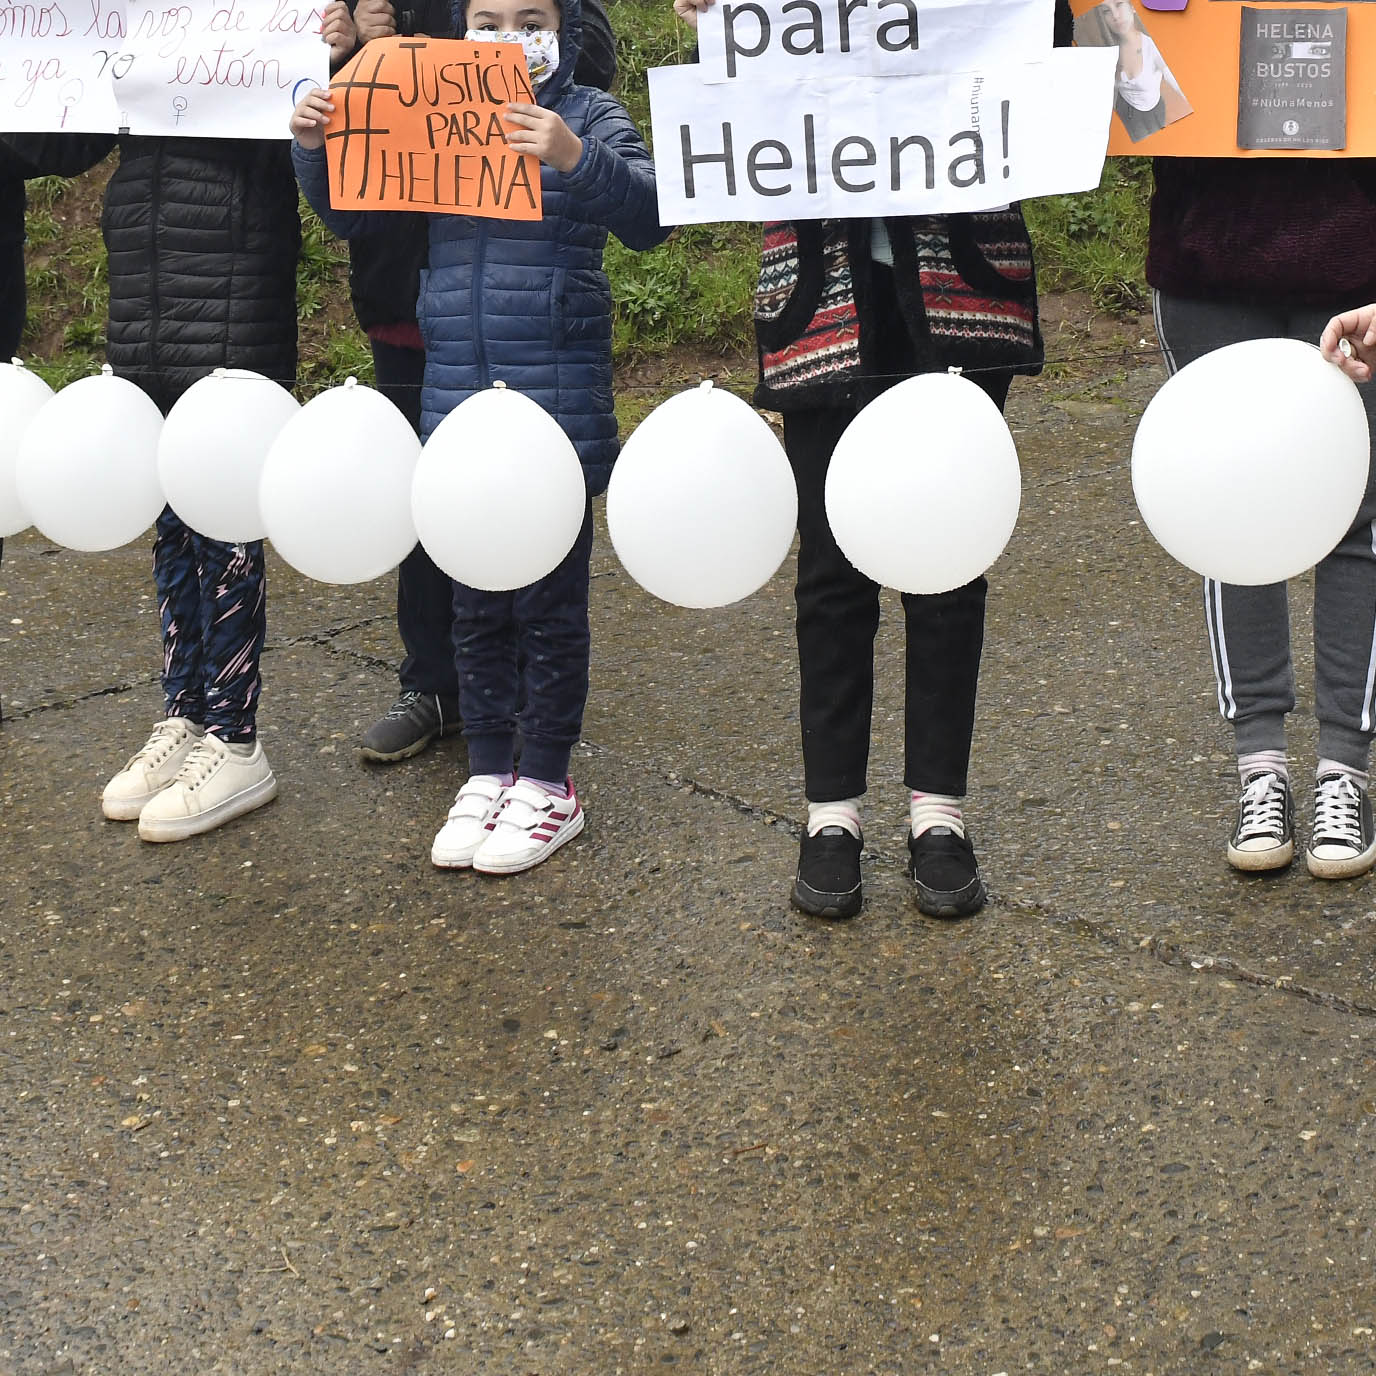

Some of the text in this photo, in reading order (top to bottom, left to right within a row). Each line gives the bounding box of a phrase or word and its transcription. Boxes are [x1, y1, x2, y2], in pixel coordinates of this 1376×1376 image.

[1256, 23, 1334, 39] HELENA
[14, 58, 67, 108] ya
[167, 39, 293, 89] están
[1256, 62, 1331, 78] BUSTOS
[425, 110, 508, 150] PARA
[679, 99, 1010, 199] Helena!
[378, 149, 537, 210] HELENA
